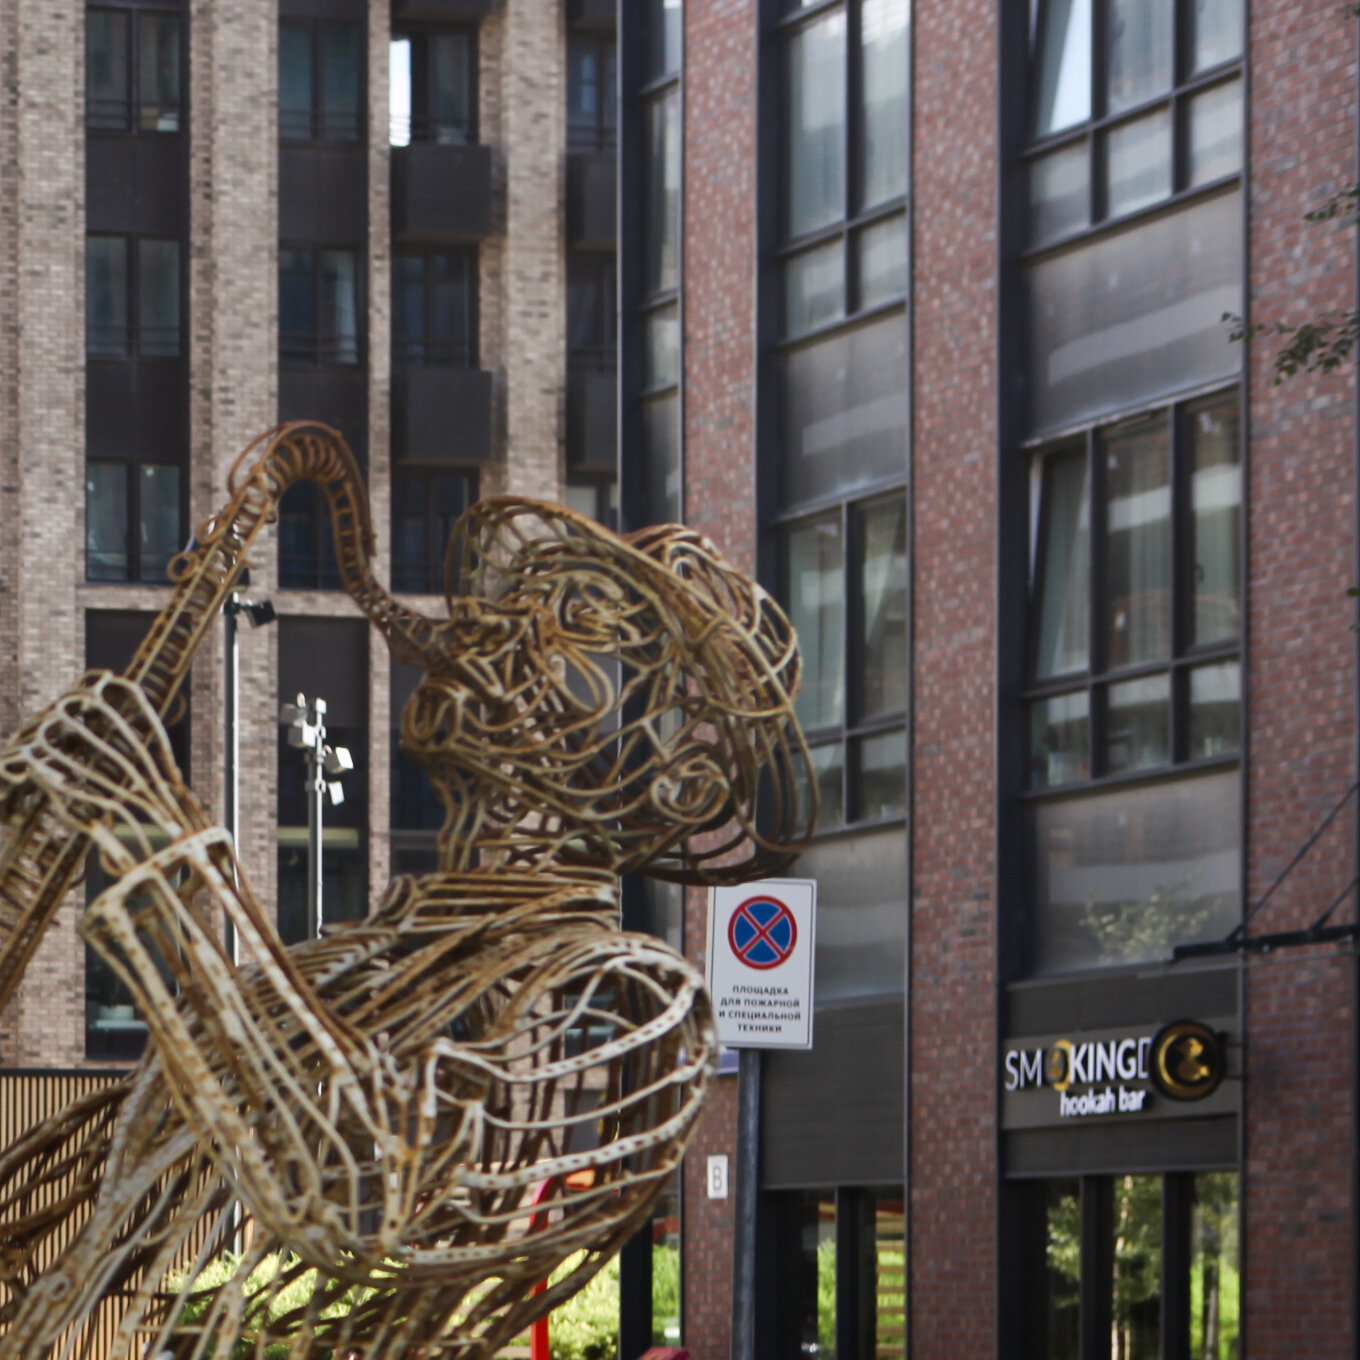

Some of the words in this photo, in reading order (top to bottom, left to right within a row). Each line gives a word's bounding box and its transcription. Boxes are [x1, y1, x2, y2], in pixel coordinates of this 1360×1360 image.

[732, 985, 789, 996] ПЛОЩАДКА
[720, 997, 741, 1007] ДЛЯ
[744, 997, 800, 1008] ПОЖАРНОЙ
[718, 1009, 726, 1019] И
[728, 1010, 801, 1021] СПЕЦИАЛЬНОЙ
[738, 1023, 782, 1033] ТЕХНИКИ
[1060, 1085, 1116, 1117] hookah
[1118, 1084, 1146, 1113] bar
